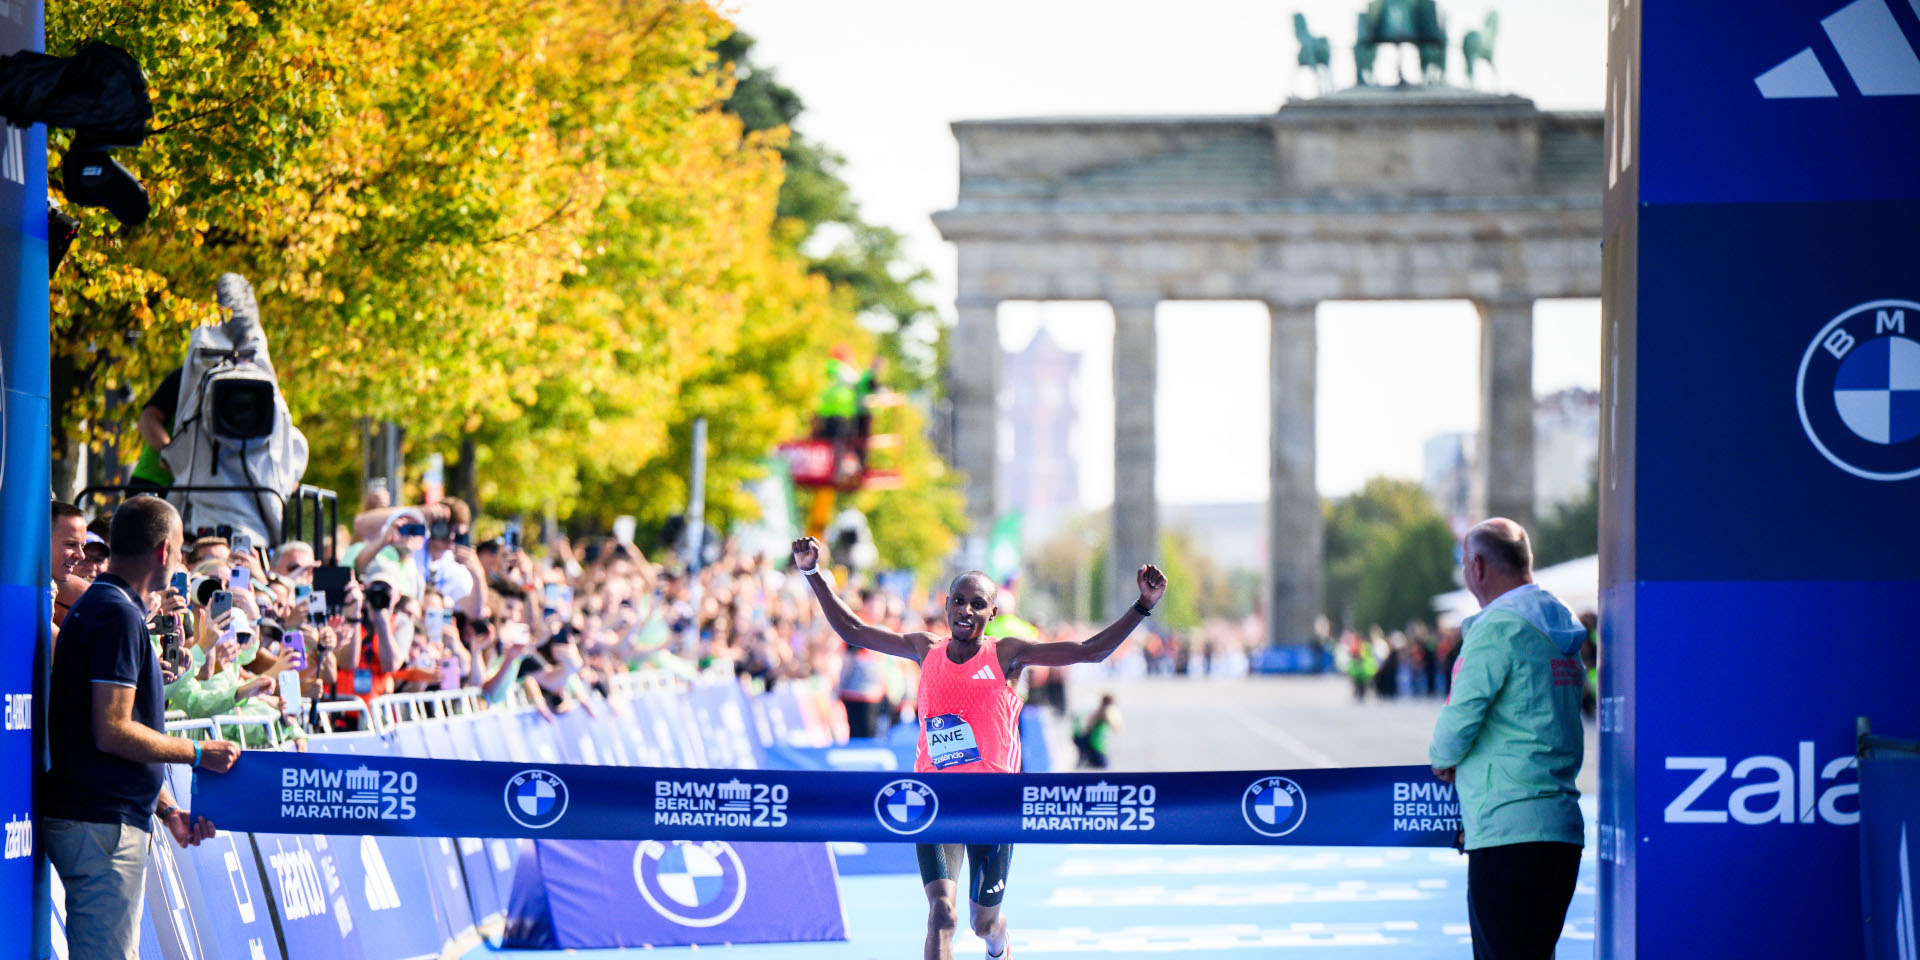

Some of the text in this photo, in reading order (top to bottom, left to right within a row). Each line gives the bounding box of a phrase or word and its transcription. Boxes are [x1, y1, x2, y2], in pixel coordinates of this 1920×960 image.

[929, 729, 964, 746] AWE
[933, 752, 964, 764] zalando
[281, 768, 418, 794] BMW 20
[514, 772, 560, 787] BMW
[1251, 779, 1298, 795] BMW
[281, 789, 343, 803] BERLIN
[654, 781, 789, 804] BMW 20
[884, 782, 930, 797] BMW
[1022, 784, 1156, 806] BMW 20
[1393, 782, 1453, 802] BMW
[281, 795, 416, 820] MARATHON 25
[654, 797, 716, 811] BERLIN
[1022, 802, 1083, 816] BERLIN
[1393, 803, 1455, 816] BERLIN
[654, 804, 788, 828] MARATHON 25
[1022, 807, 1155, 831] MARATHON 25
[4, 812, 33, 860] zalando
